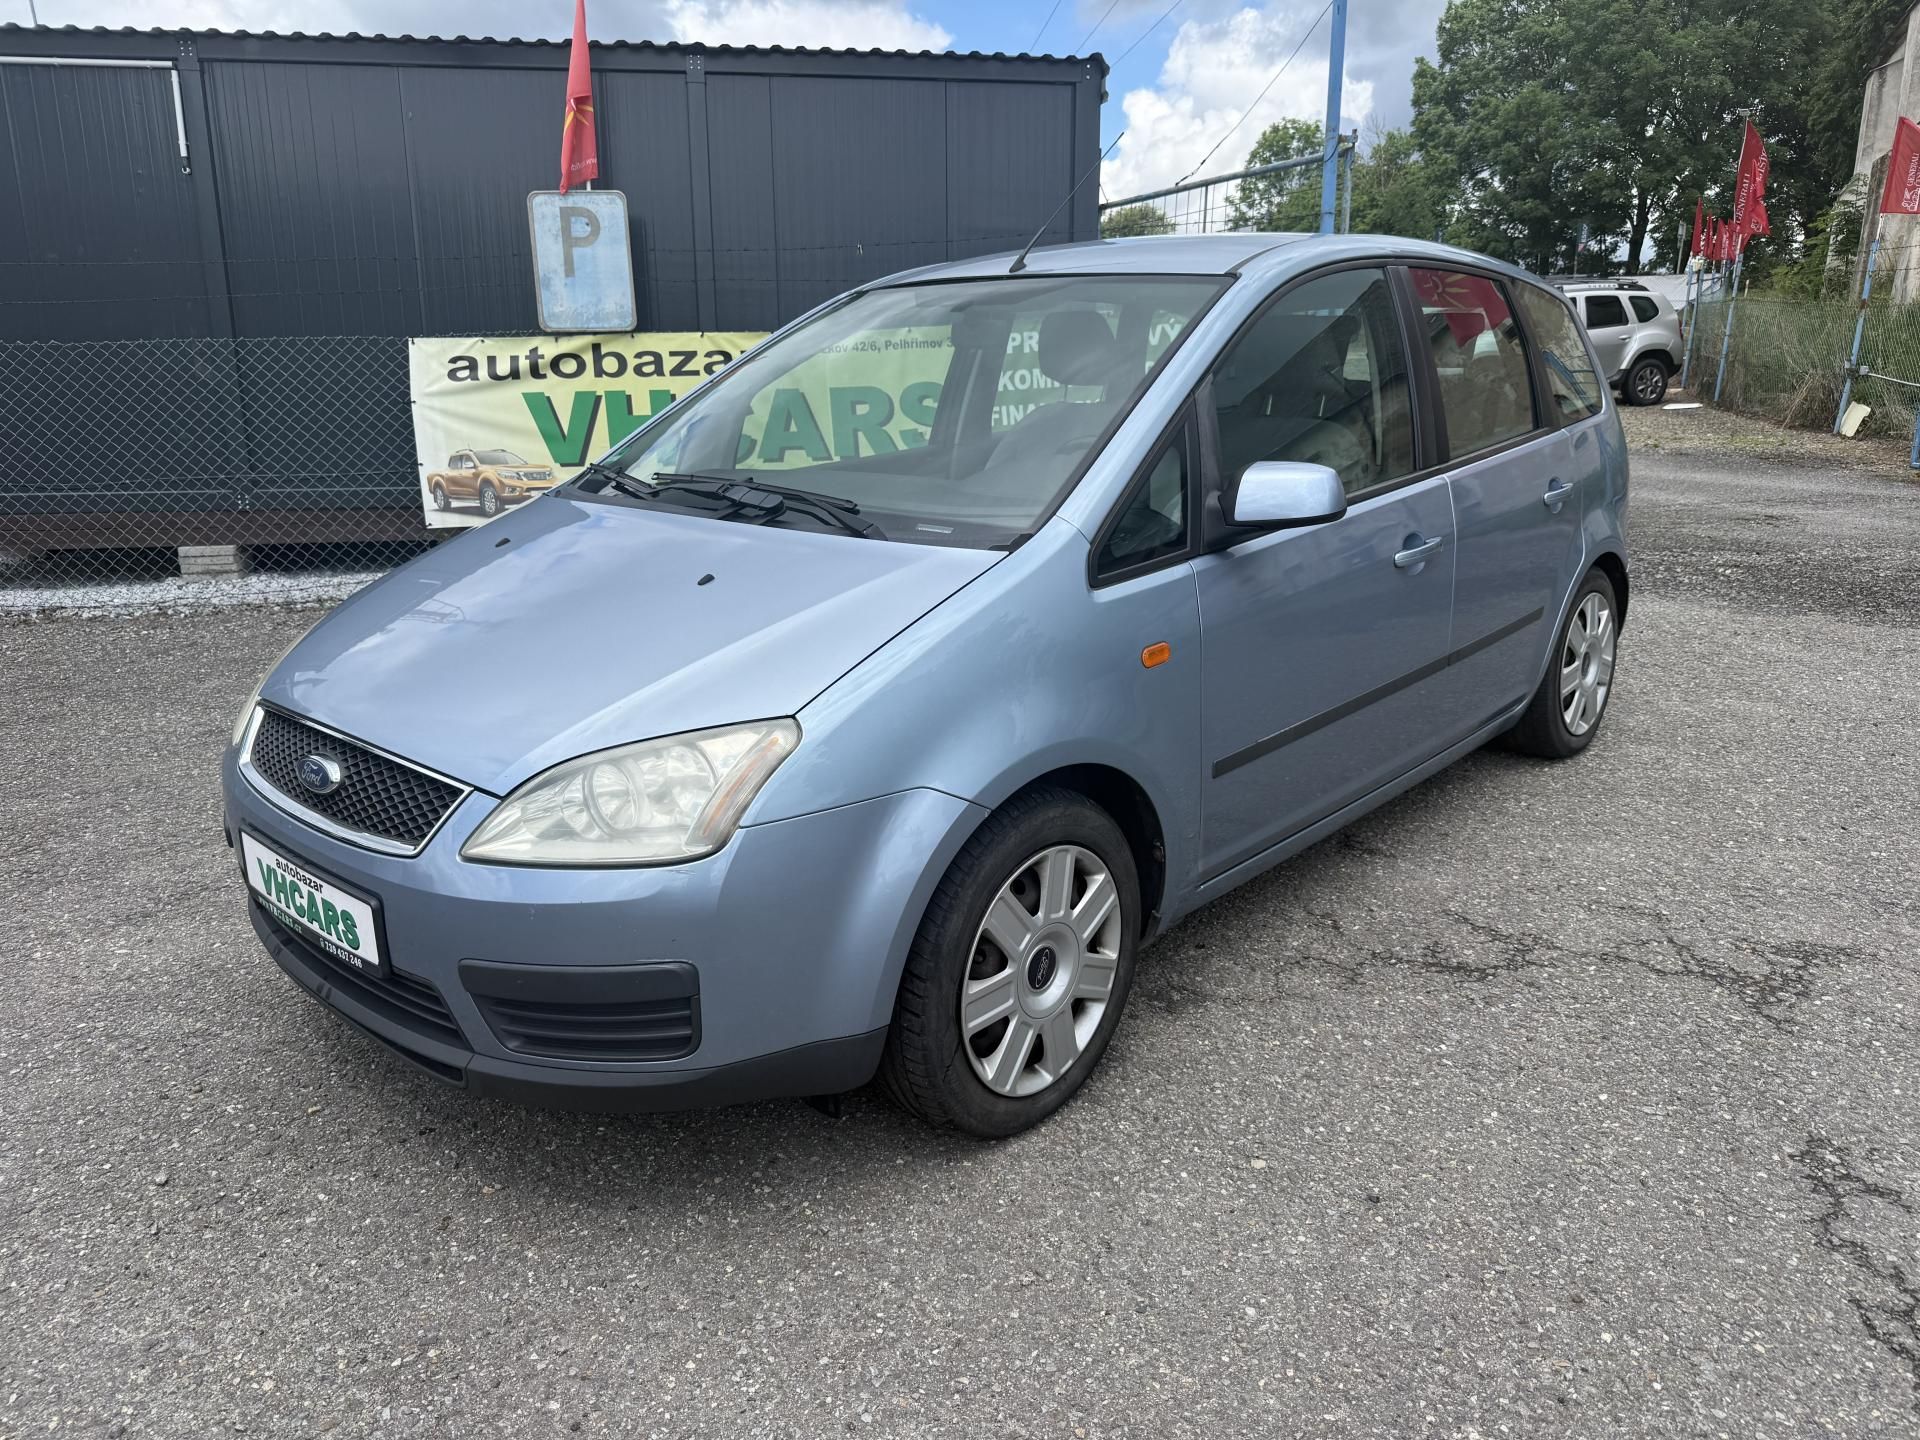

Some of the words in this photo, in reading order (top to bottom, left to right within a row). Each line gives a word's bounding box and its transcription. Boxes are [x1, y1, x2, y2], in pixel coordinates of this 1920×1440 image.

[558, 206, 601, 278] P
[446, 343, 747, 382] autobaza
[884, 338, 943, 351] Pelhřimov
[301, 761, 324, 786] Ford
[275, 858, 324, 894] autobazar
[256, 857, 361, 951] VHCARS
